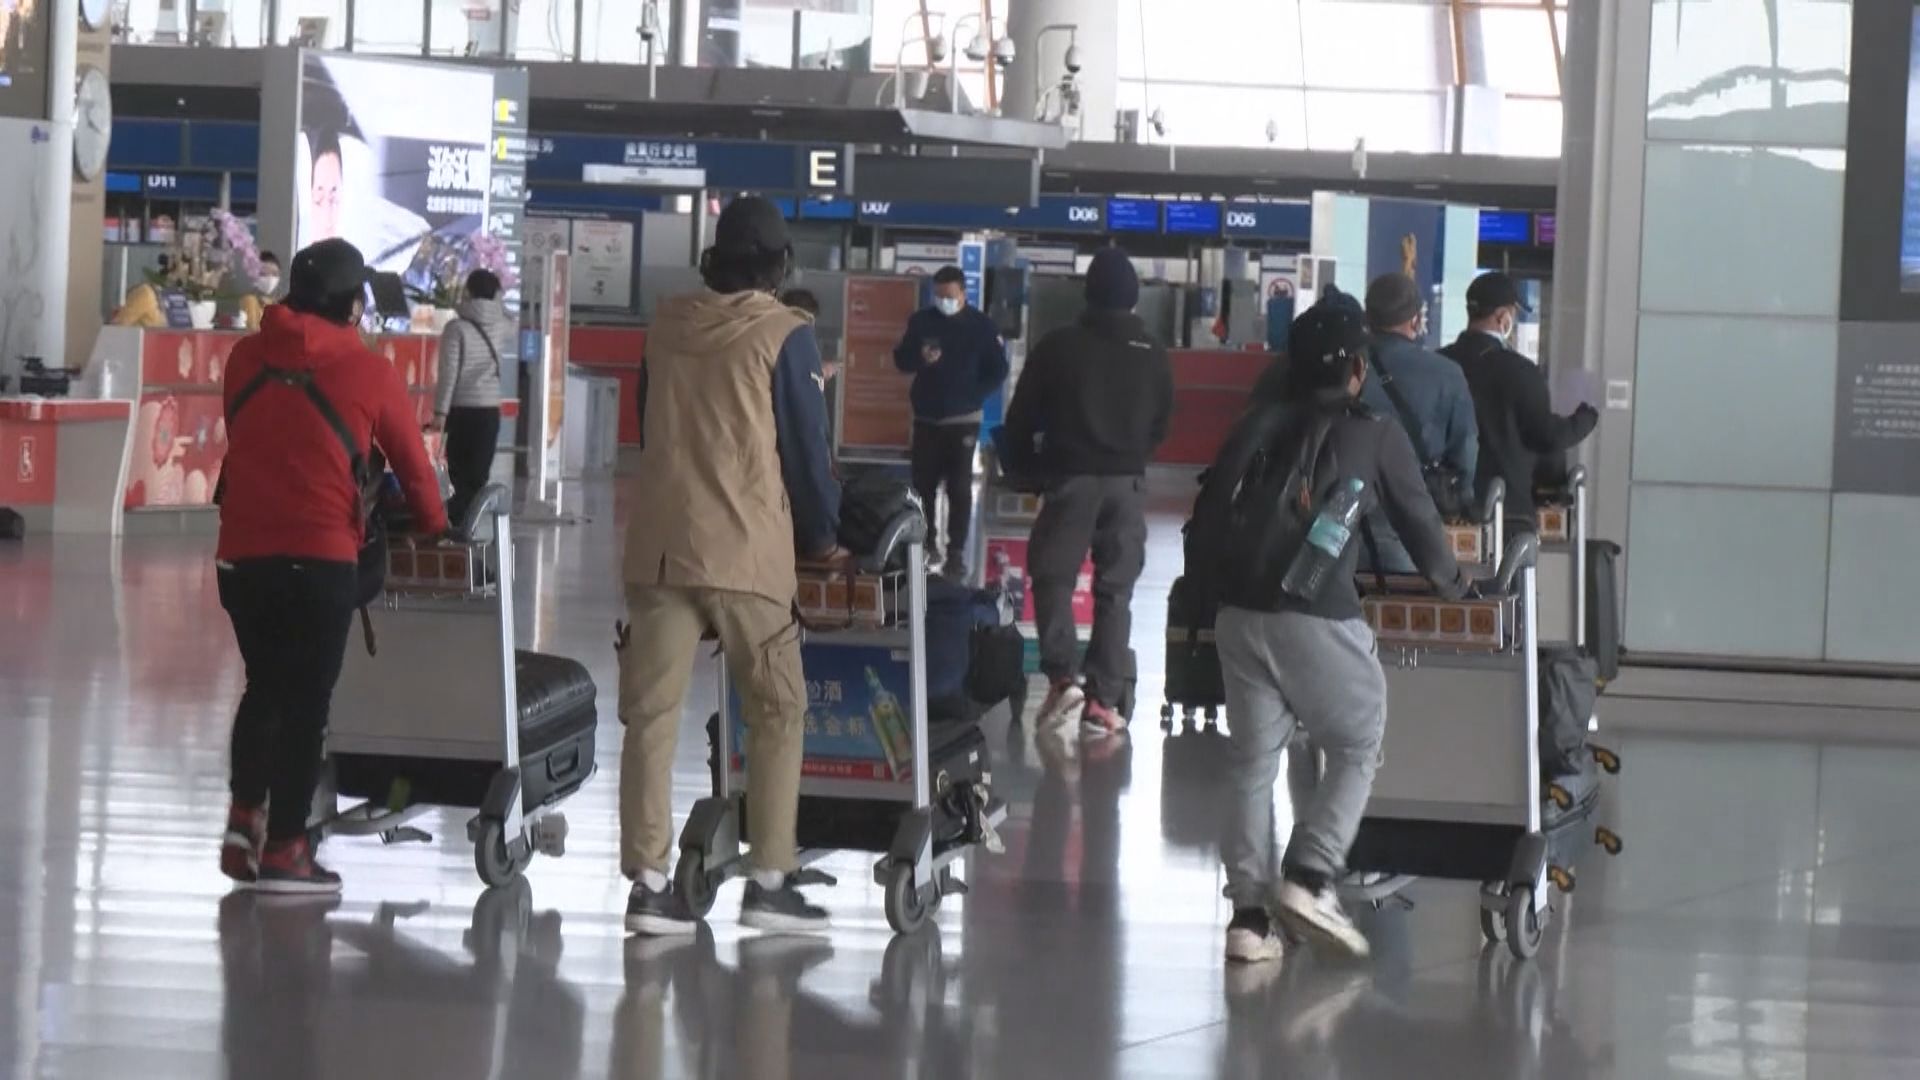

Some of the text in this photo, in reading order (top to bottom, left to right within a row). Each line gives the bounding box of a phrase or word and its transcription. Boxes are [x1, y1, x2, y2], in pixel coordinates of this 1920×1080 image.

[810, 151, 837, 187] E
[148, 174, 176, 188] D11
[861, 201, 890, 214] D07
[1069, 206, 1098, 222] D06
[1227, 212, 1256, 227] D05
